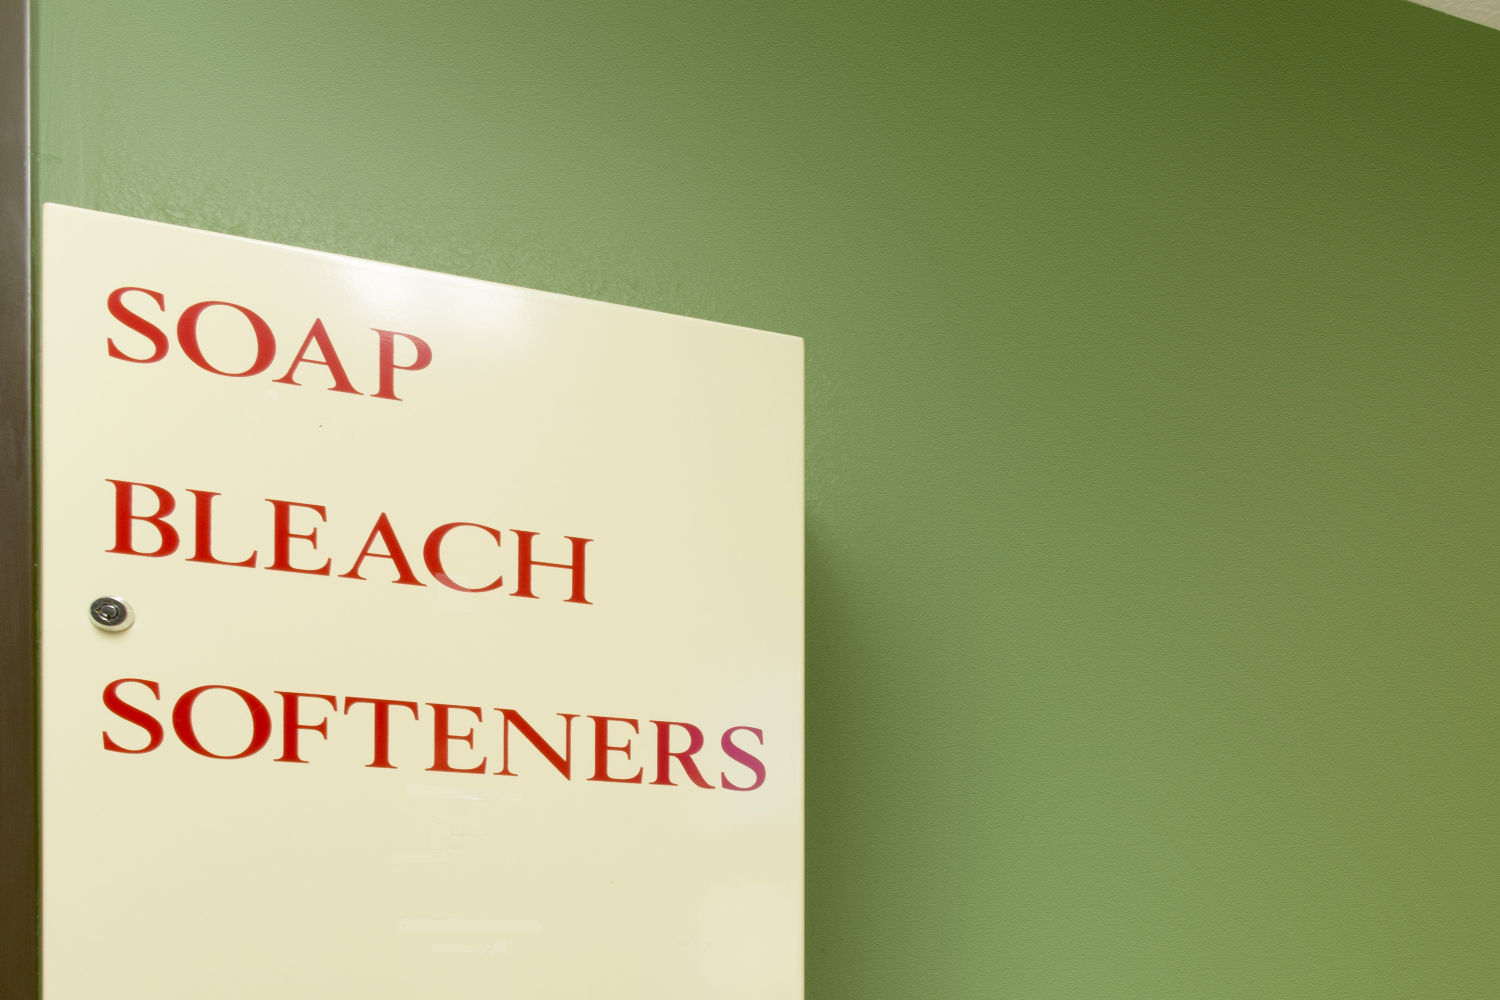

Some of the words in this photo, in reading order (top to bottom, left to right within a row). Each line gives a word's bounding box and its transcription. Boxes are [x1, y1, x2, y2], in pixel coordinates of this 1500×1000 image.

[106, 286, 432, 401] SOAP
[104, 478, 594, 605] BLEACH
[101, 677, 767, 792] SOFTENERS
